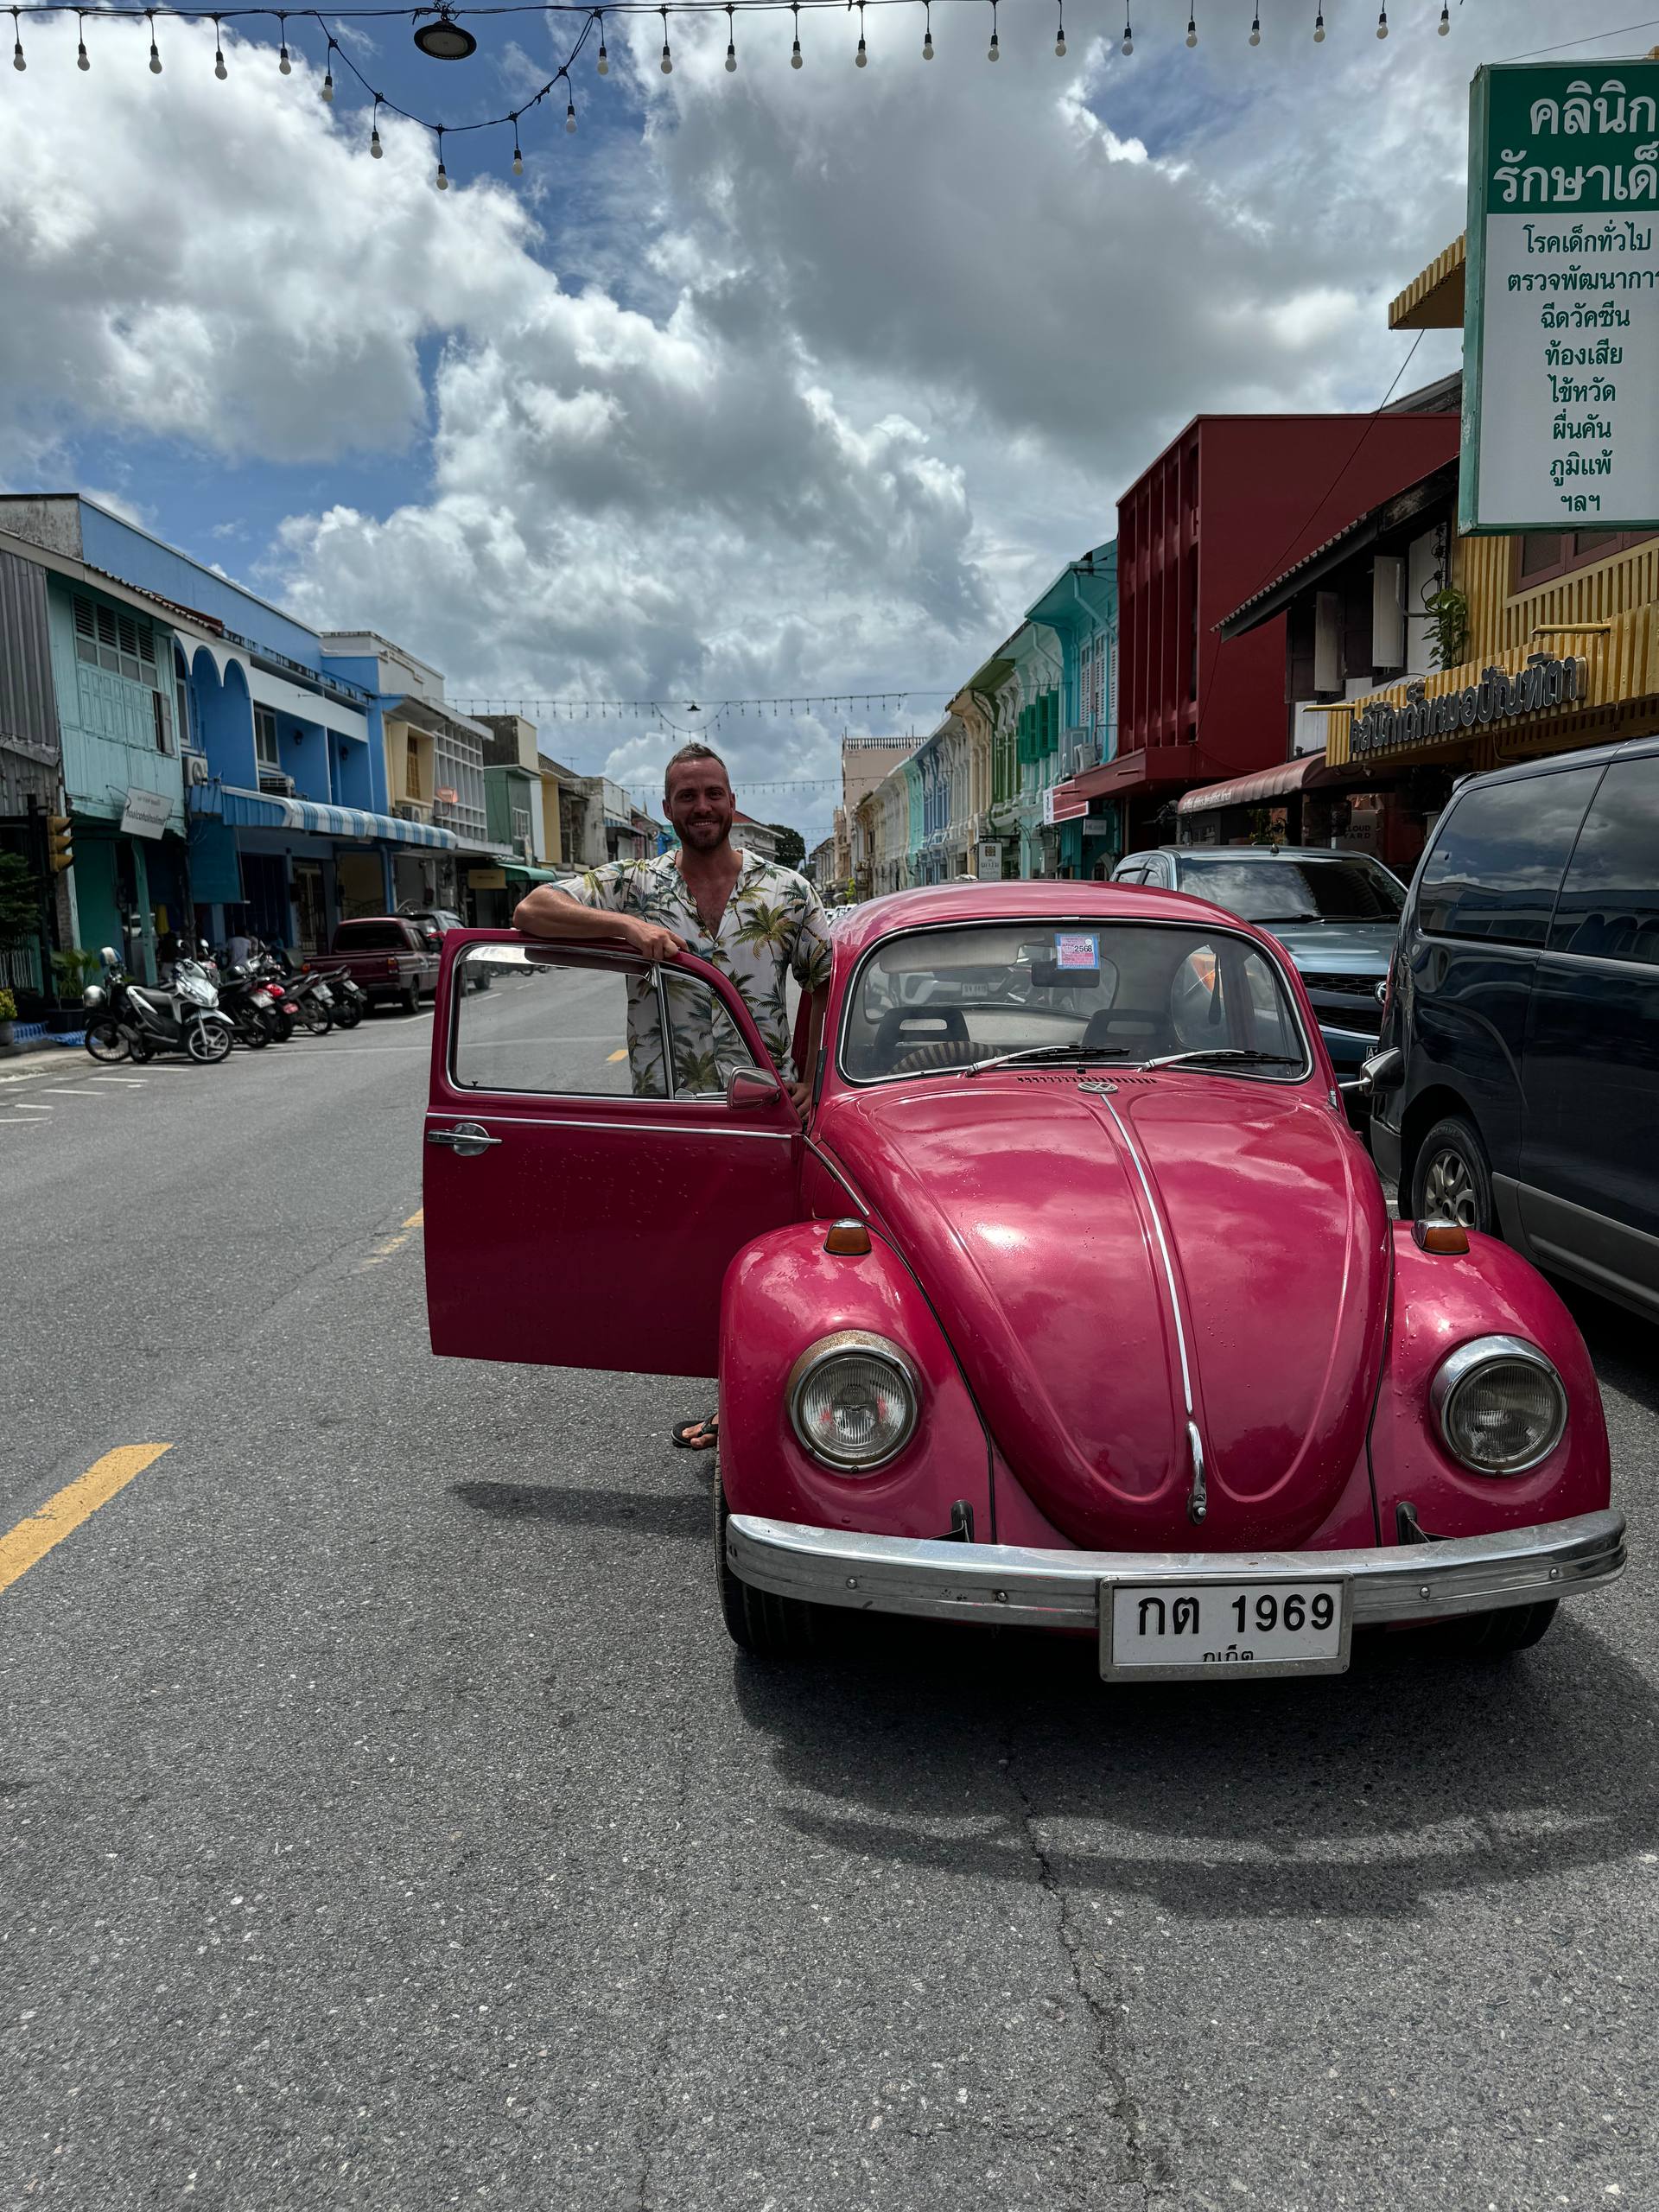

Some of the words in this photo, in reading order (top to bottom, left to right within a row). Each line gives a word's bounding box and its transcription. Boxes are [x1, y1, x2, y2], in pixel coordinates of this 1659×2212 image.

[1529, 79, 1656, 135] คลินิก
[1522, 219, 1651, 254] โรคเด็กทั่วไป
[1541, 300, 1630, 329] ฉีดวัคซีน
[1545, 339, 1623, 366] ท้องเสีย
[1547, 374, 1616, 403] ไข้หวัด
[1553, 409, 1612, 440] ผื่นคัน
[1549, 449, 1613, 486] ภูมิแพ้
[1560, 494, 1601, 512] ฯลฯ
[1137, 1596, 1199, 1636] กต
[1231, 1592, 1335, 1633] 1969
[1202, 1643, 1254, 1662] ภเก็ต
